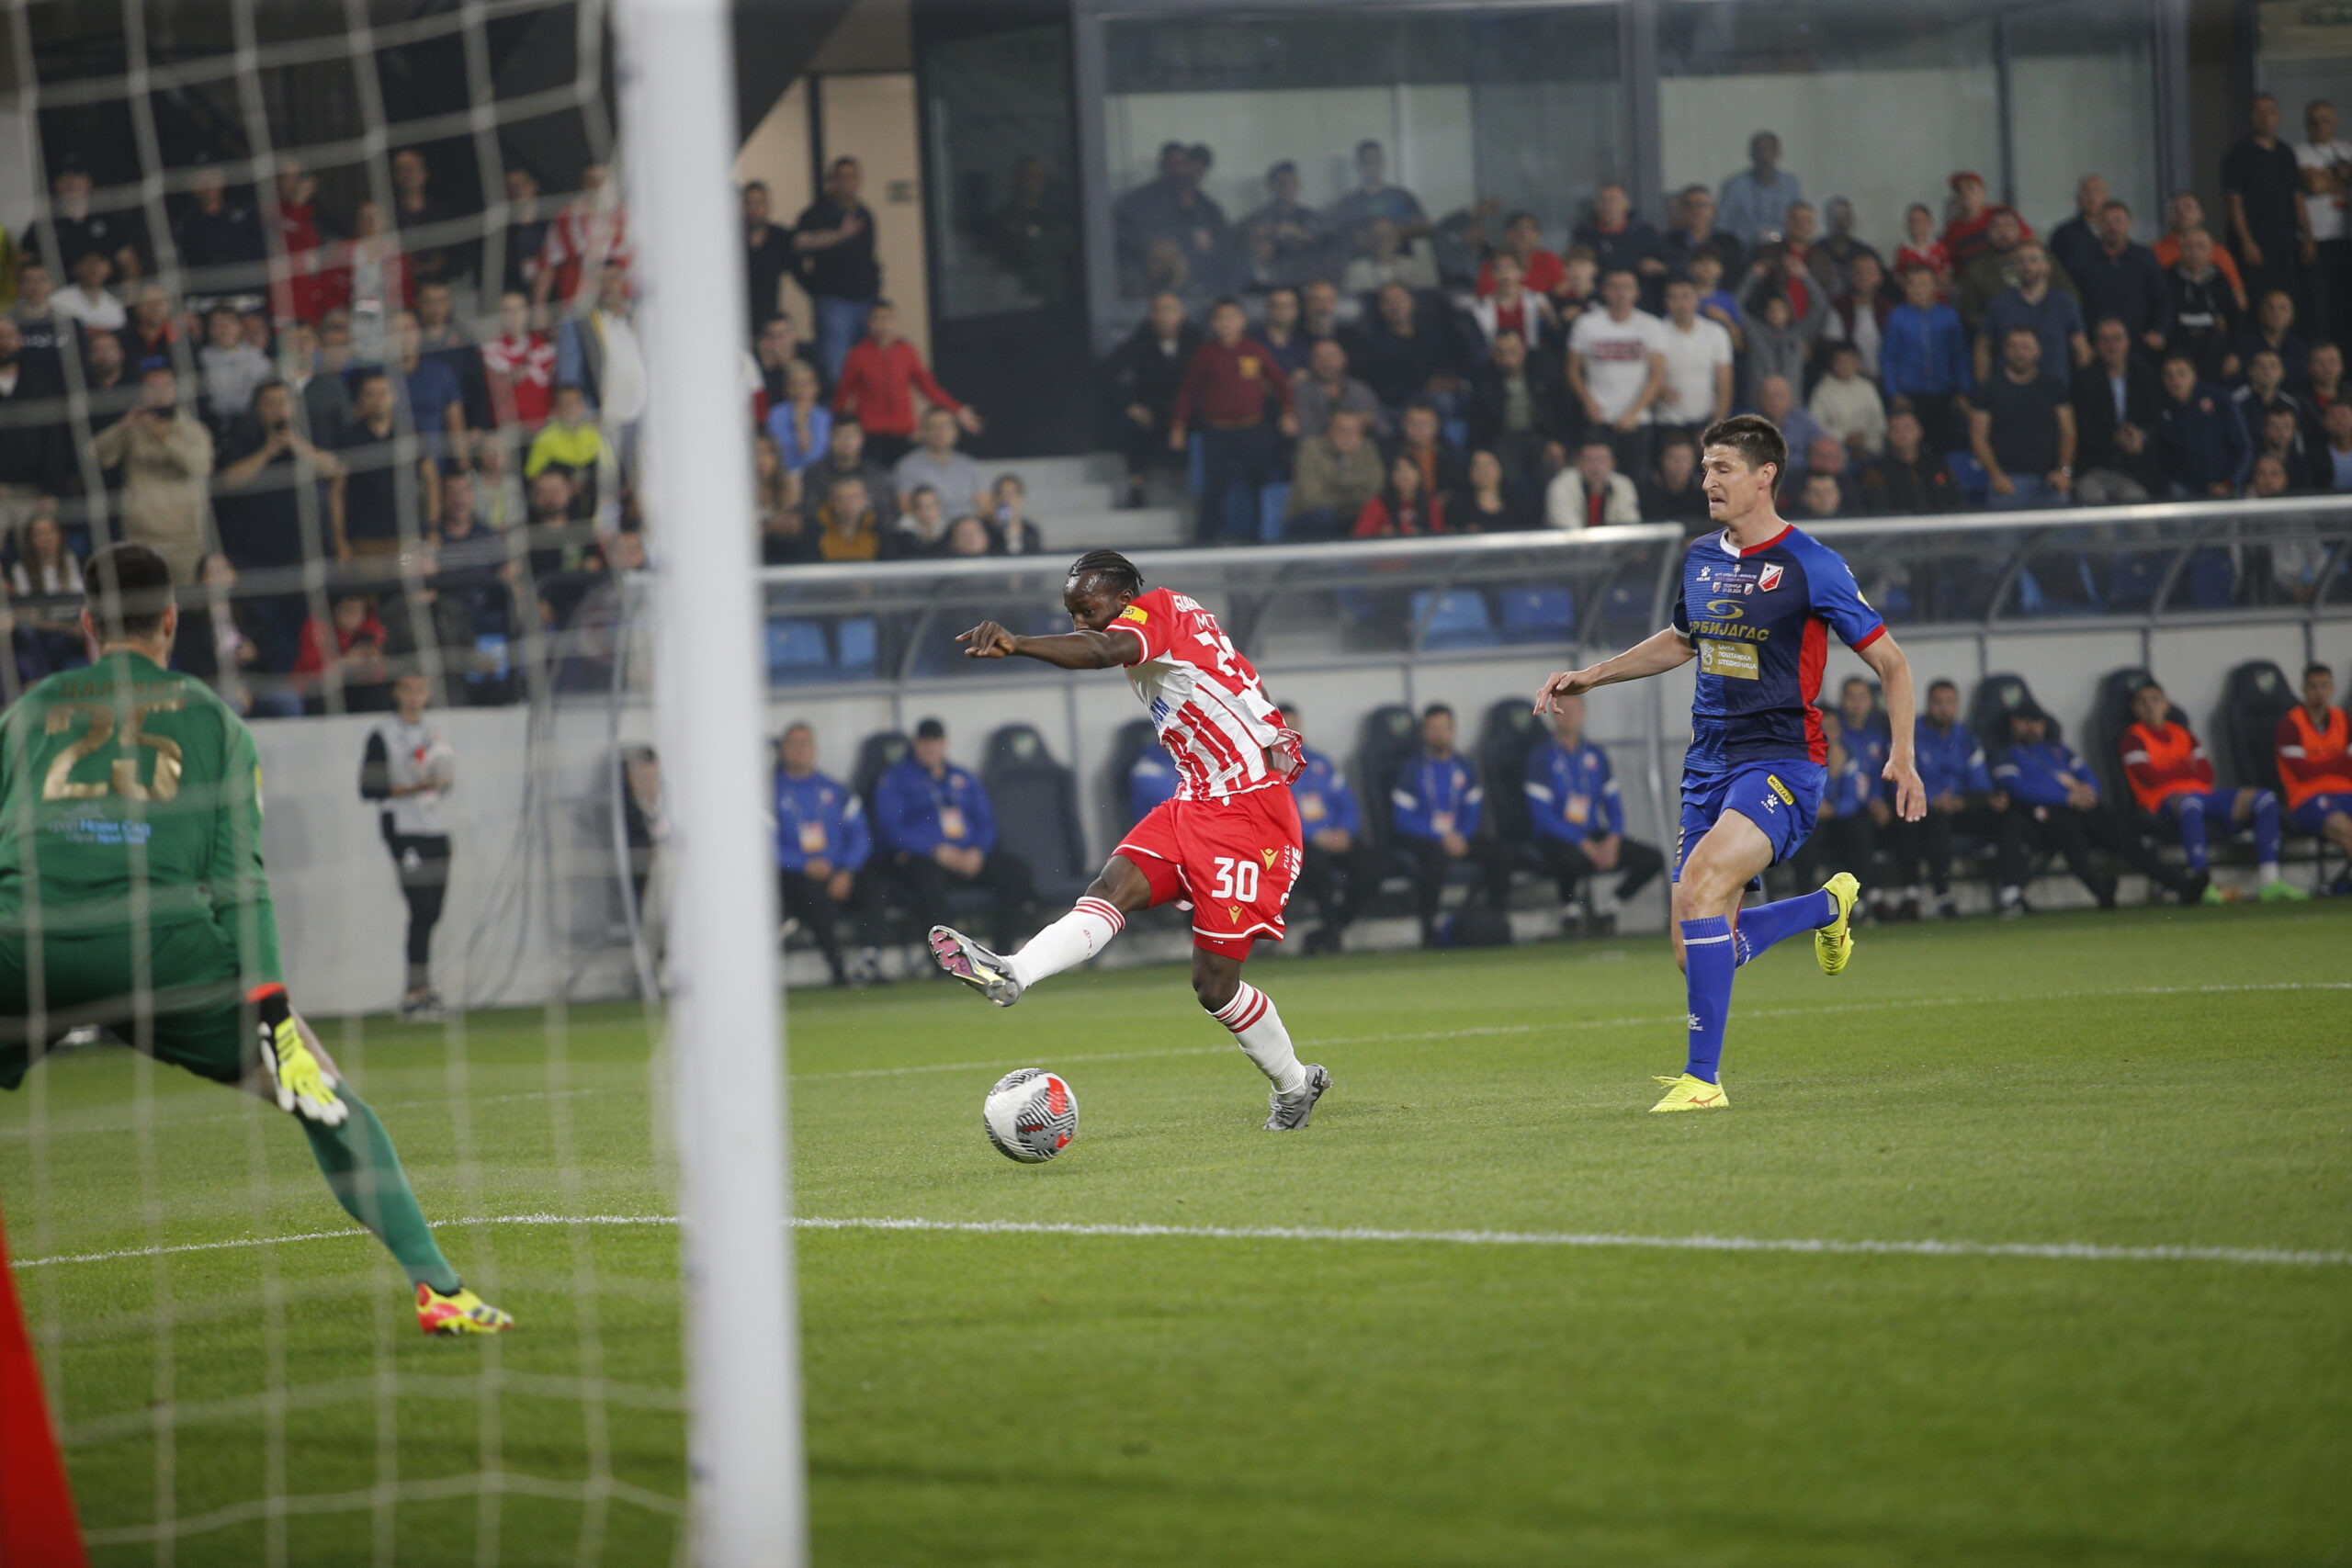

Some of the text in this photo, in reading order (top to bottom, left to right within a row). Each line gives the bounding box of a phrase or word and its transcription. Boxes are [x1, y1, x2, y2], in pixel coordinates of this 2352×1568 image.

[1690, 620, 1770, 641] РБИЈАГАС
[41, 700, 187, 801] 25
[1769, 778, 1792, 803] MOZZART
[1211, 856, 1259, 903] 30
